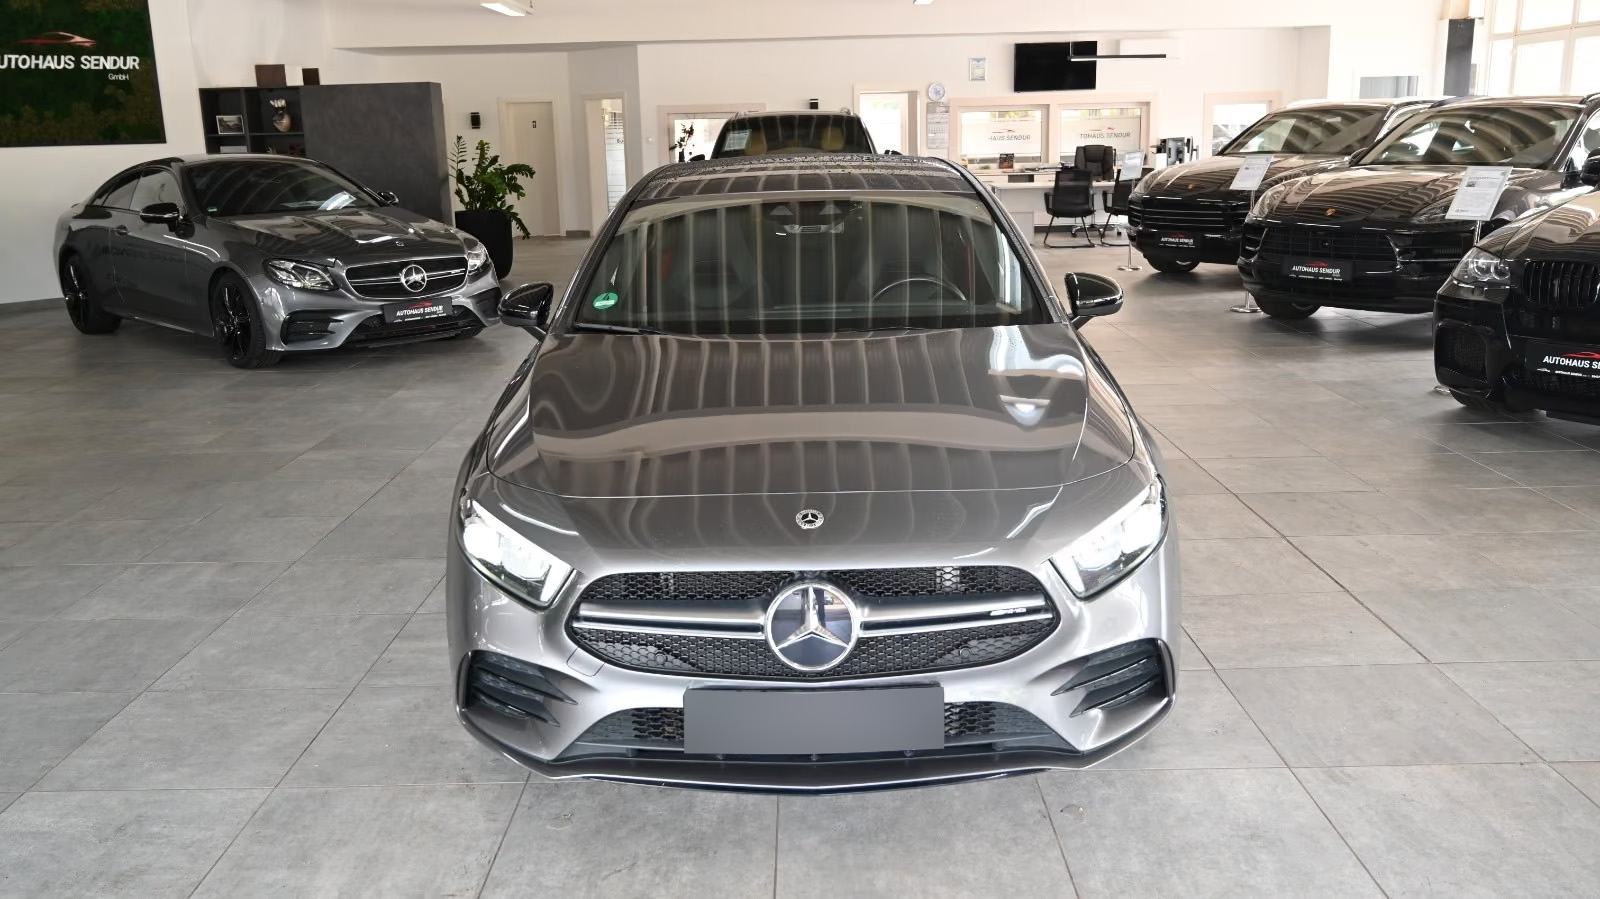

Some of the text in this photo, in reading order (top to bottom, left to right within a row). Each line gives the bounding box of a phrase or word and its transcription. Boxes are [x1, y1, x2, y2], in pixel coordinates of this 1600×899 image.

[80, 55, 140, 70] SENDUR
[108, 73, 129, 81] GmbH
[1292, 265, 1319, 273] AUTOHAUS
[396, 308, 424, 316] AUTOHAUS
[1543, 355, 1590, 368] AUTOHAUS
